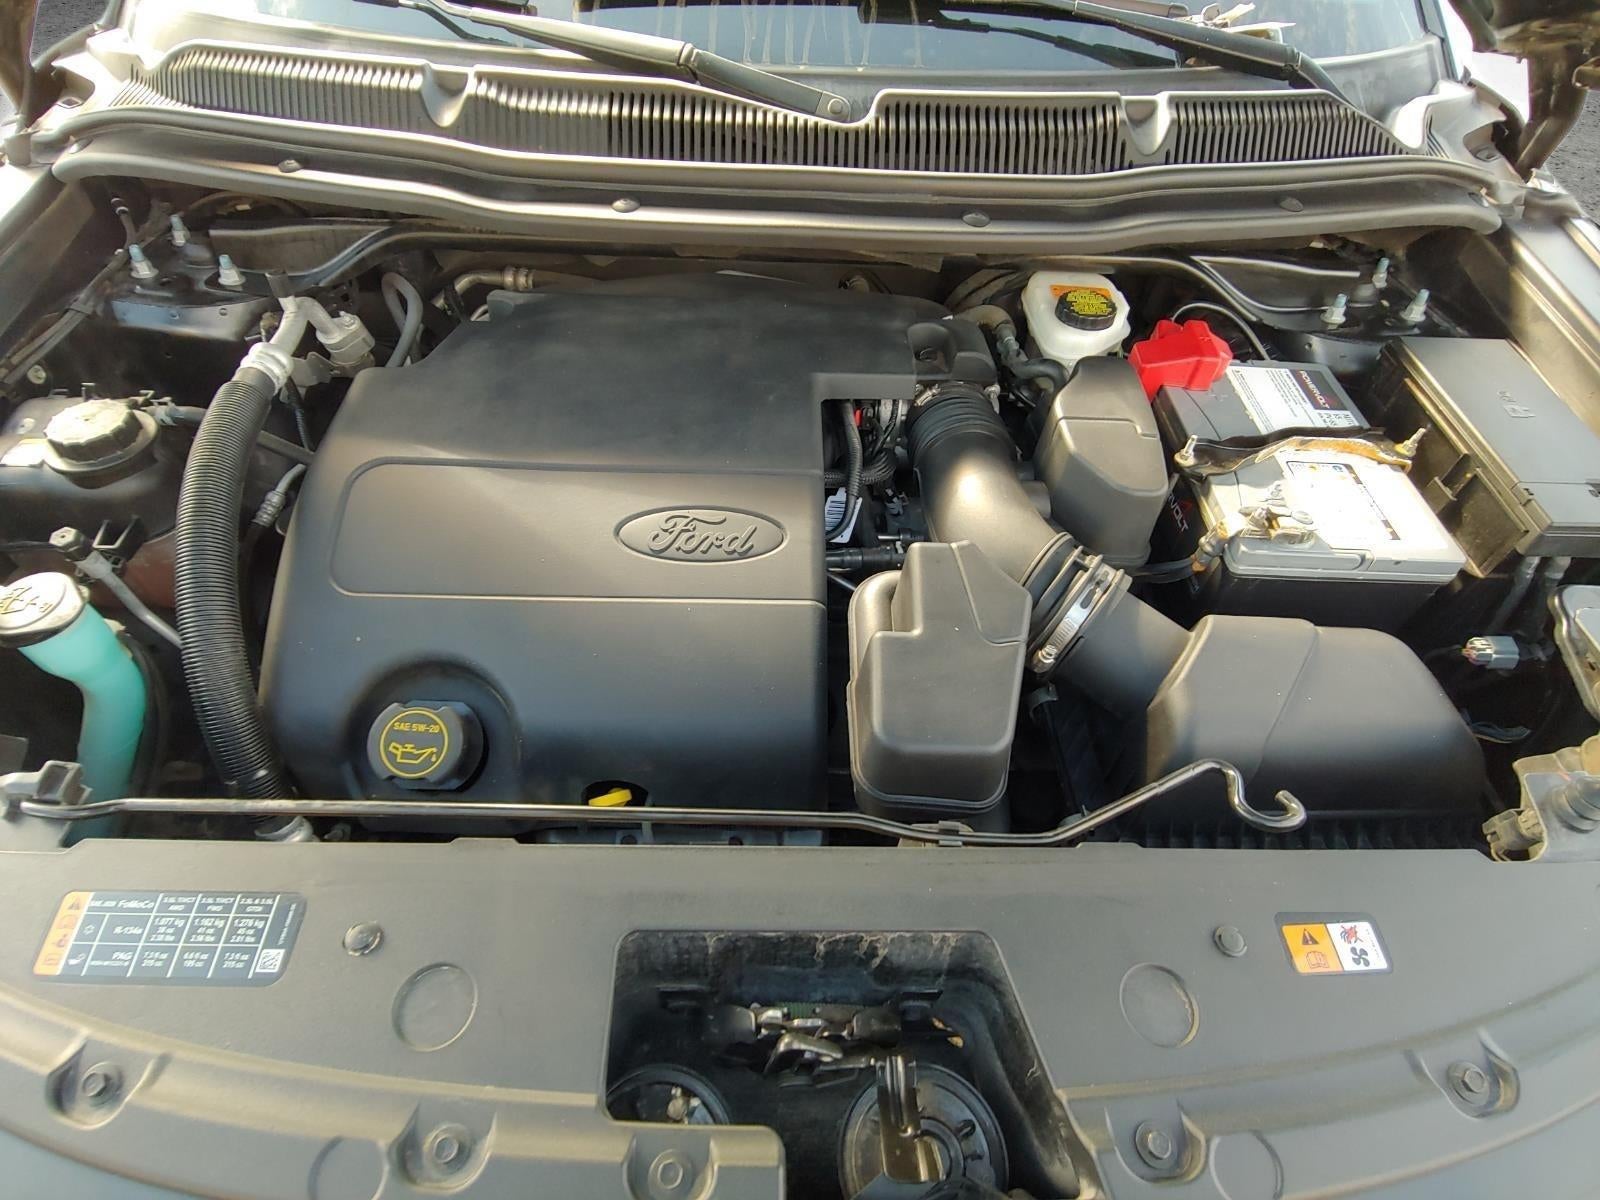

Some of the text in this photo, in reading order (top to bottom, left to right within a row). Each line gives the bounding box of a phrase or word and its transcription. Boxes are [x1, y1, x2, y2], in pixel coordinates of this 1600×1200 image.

[1300, 370, 1330, 409] POWERVOLT
[648, 514, 758, 556] Ford
[393, 721, 440, 733] SAE 5W-20
[117, 899, 155, 909] FoMoCo
[112, 952, 134, 960] PAG
